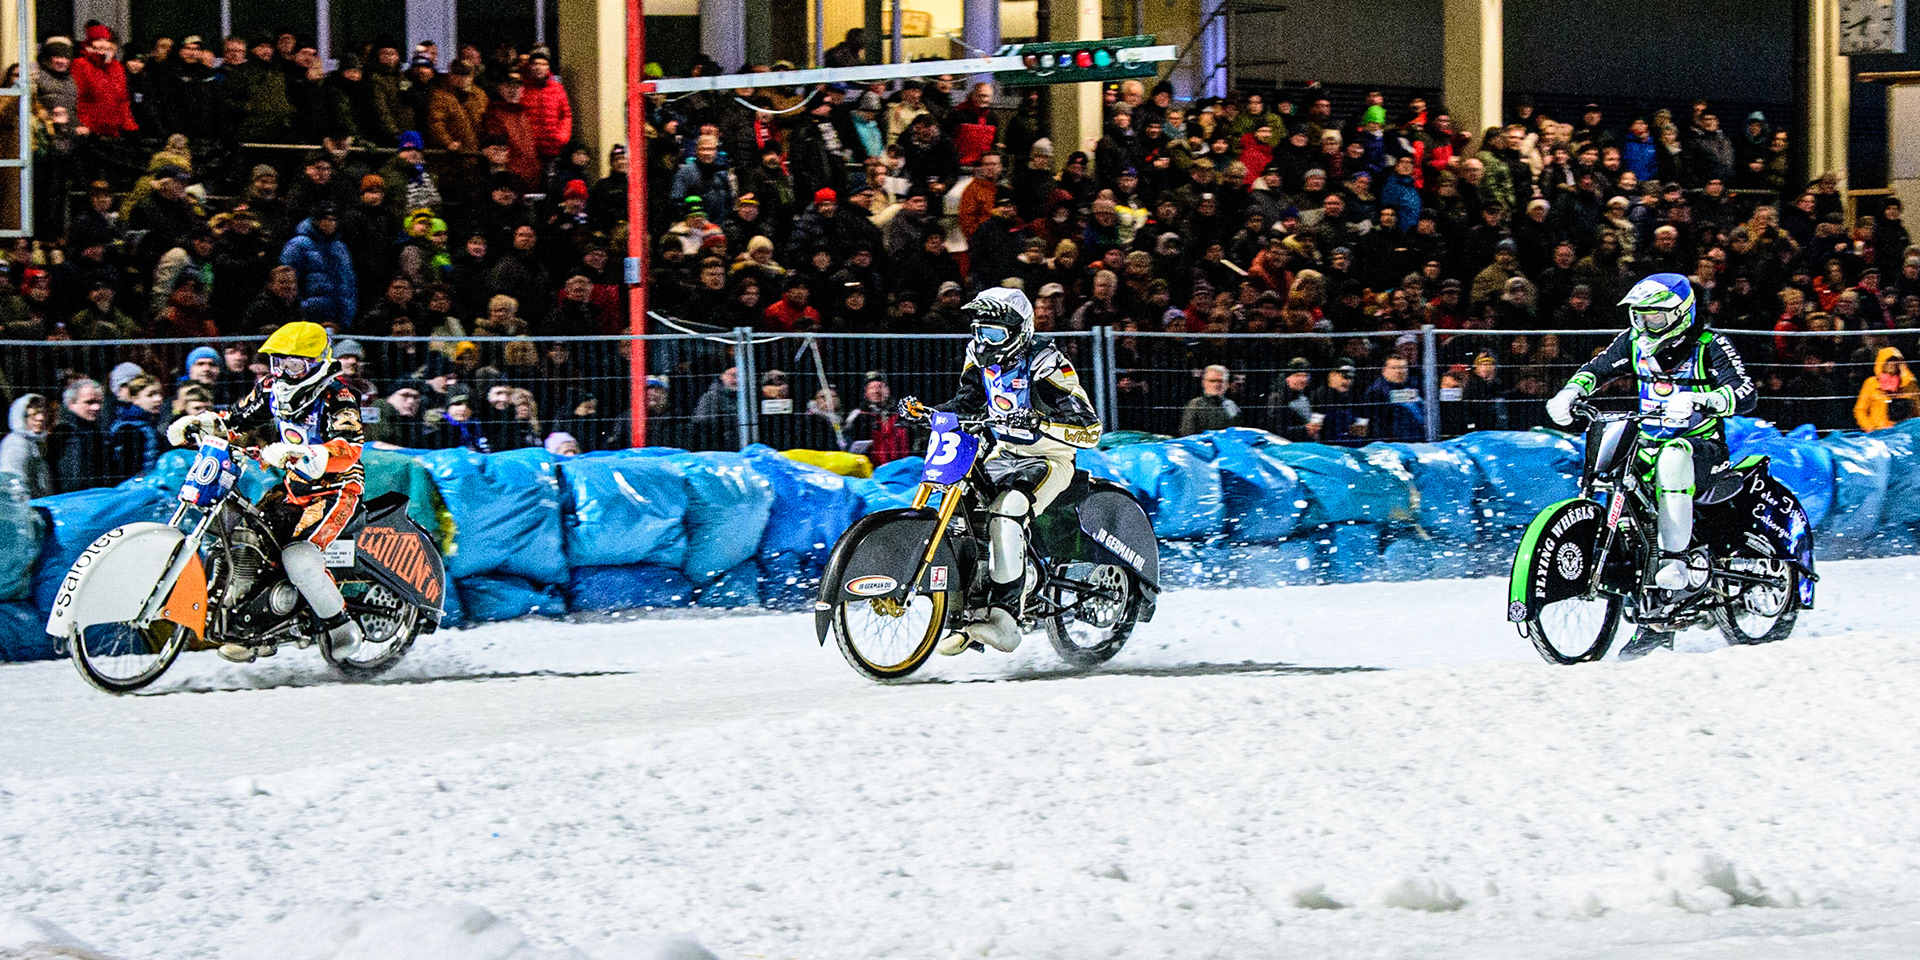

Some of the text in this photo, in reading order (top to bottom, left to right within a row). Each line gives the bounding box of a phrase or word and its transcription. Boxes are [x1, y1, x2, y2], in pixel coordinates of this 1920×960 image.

[924, 430, 961, 466] 93
[1096, 528, 1146, 571] JB GERMAN OIL
[1535, 537, 1556, 598] FLYING
[1551, 506, 1595, 538] WHEELS
